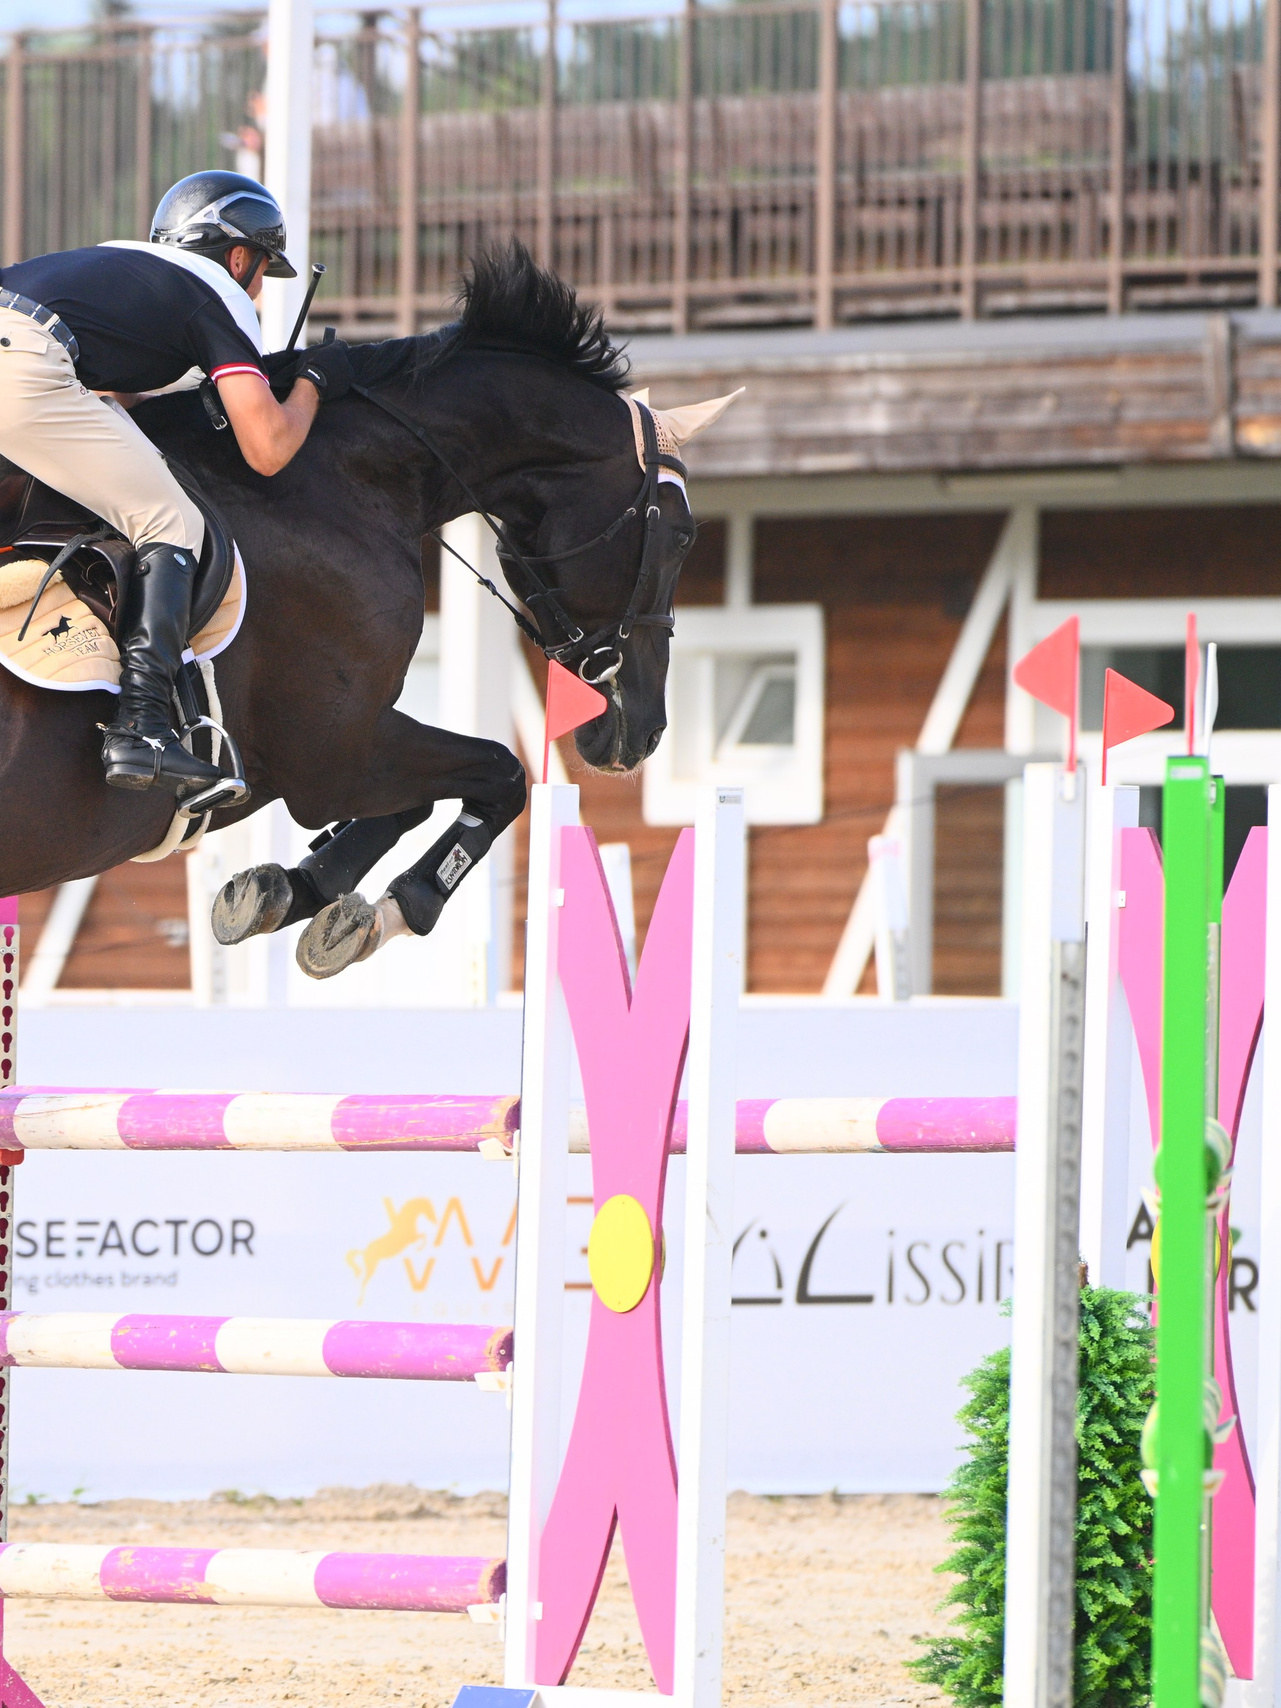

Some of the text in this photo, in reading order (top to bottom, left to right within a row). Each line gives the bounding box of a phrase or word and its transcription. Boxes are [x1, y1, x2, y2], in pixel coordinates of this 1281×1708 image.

[43, 626, 101, 656] HORSEVET
[71, 642, 101, 656] TEAM
[44, 1270, 115, 1288] clothes
[121, 1269, 179, 1288] brand
